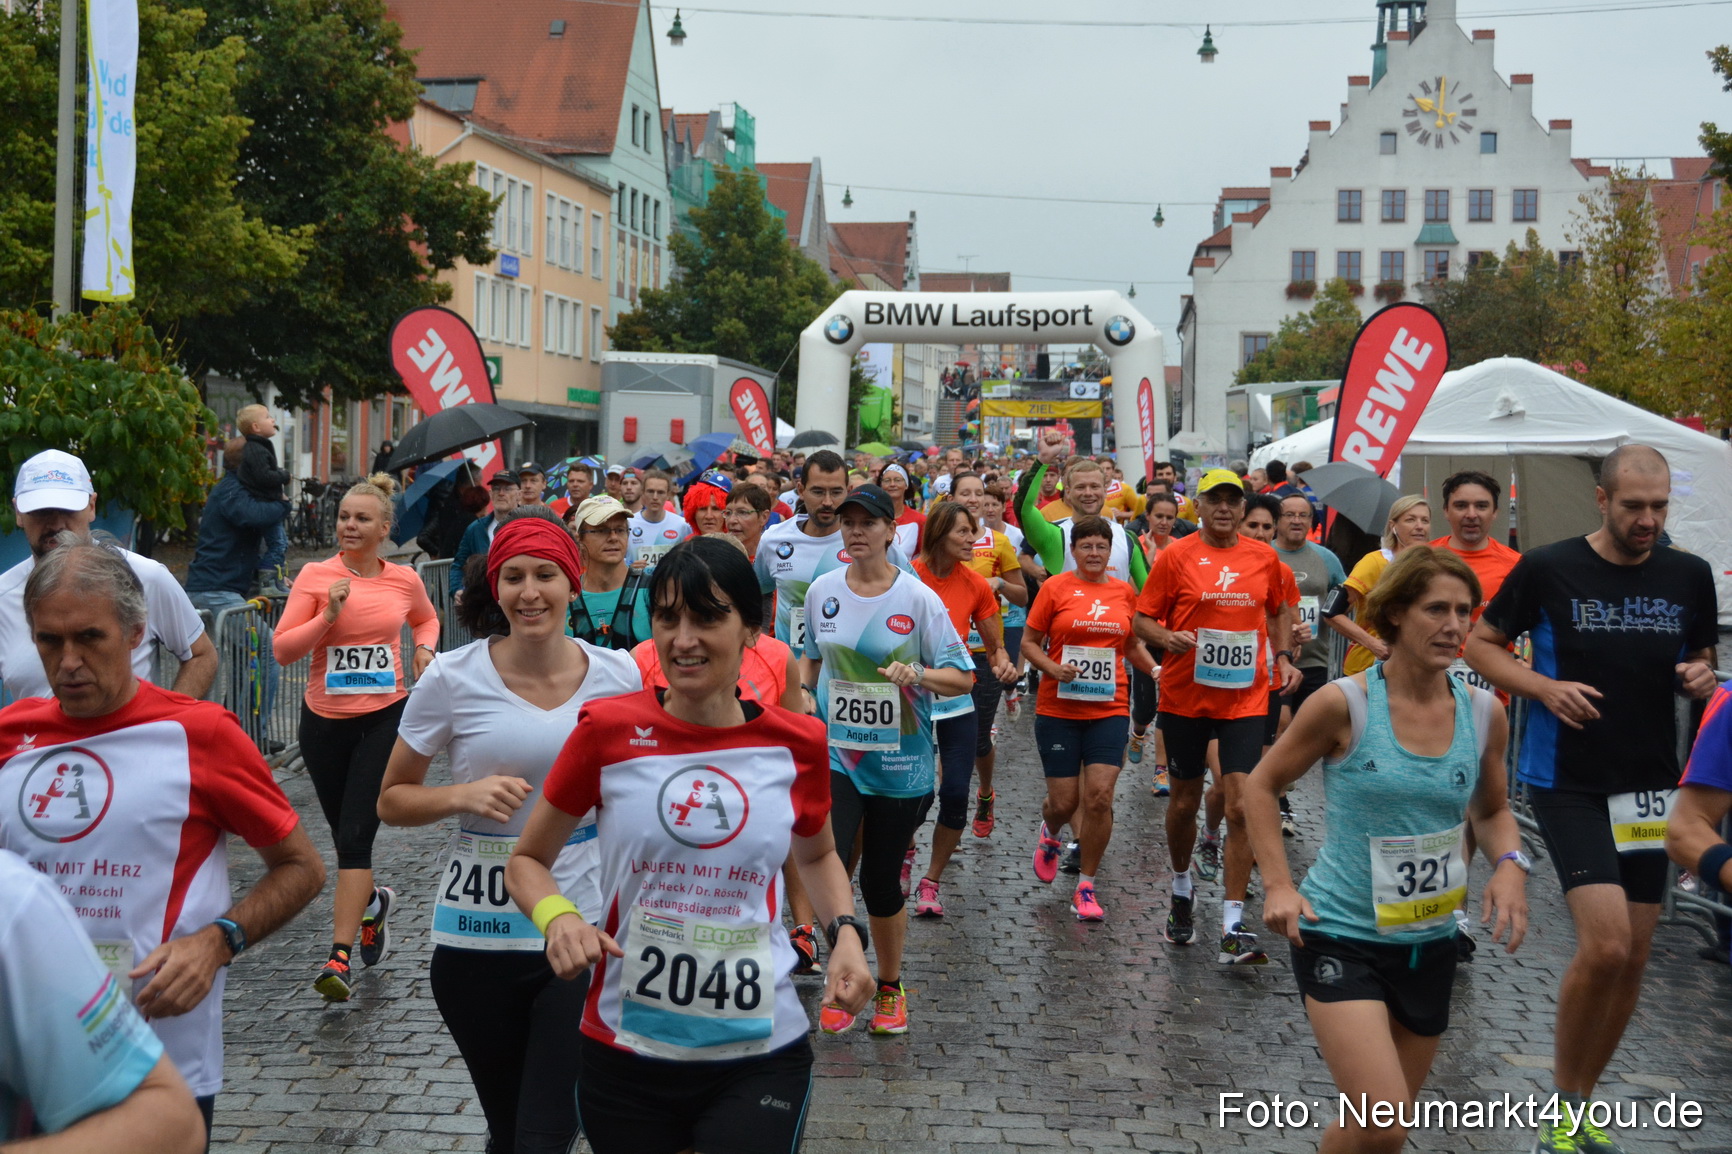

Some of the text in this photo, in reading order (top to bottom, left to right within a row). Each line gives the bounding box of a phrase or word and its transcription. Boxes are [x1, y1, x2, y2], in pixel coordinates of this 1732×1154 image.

[864, 302, 1093, 331] BMW Laufsport
[1341, 327, 1433, 472] REWE
[1028, 403, 1056, 415] ZIEL
[1201, 592, 1250, 600] funrunners
[1216, 599, 1256, 607] neumarkt
[1300, 607, 1315, 622] 04
[1623, 596, 1683, 616] HiRo
[1072, 619, 1121, 629] funrunners
[1086, 627, 1125, 635] neumarkt
[335, 646, 389, 671] 2673
[1203, 643, 1252, 666] 3085
[345, 676, 377, 685] Denisa
[1070, 684, 1105, 693] Michaela
[835, 697, 894, 725] 2650
[629, 738, 658, 747] erima
[846, 729, 879, 743] Angela
[881, 763, 913, 771] Stadtlauf
[1635, 790, 1678, 818] 95
[1631, 827, 1666, 839] Manue
[479, 840, 519, 855] BOC
[93, 859, 142, 878] HERZ
[631, 859, 766, 887] LAUFEN MIT HERZ
[79, 884, 124, 898] Röschl
[445, 859, 511, 907] 240
[642, 880, 656, 890] Dr.
[658, 881, 686, 893] Heck
[695, 886, 711, 897] Dr.
[713, 888, 748, 900] Röschl
[639, 897, 742, 917] Leistungsdiagnostik
[1414, 903, 1439, 919] Lisa
[458, 915, 511, 934] Bianka
[640, 924, 685, 941] NeuerMarkt
[693, 925, 759, 946] BOCK
[635, 945, 762, 1011] 2048
